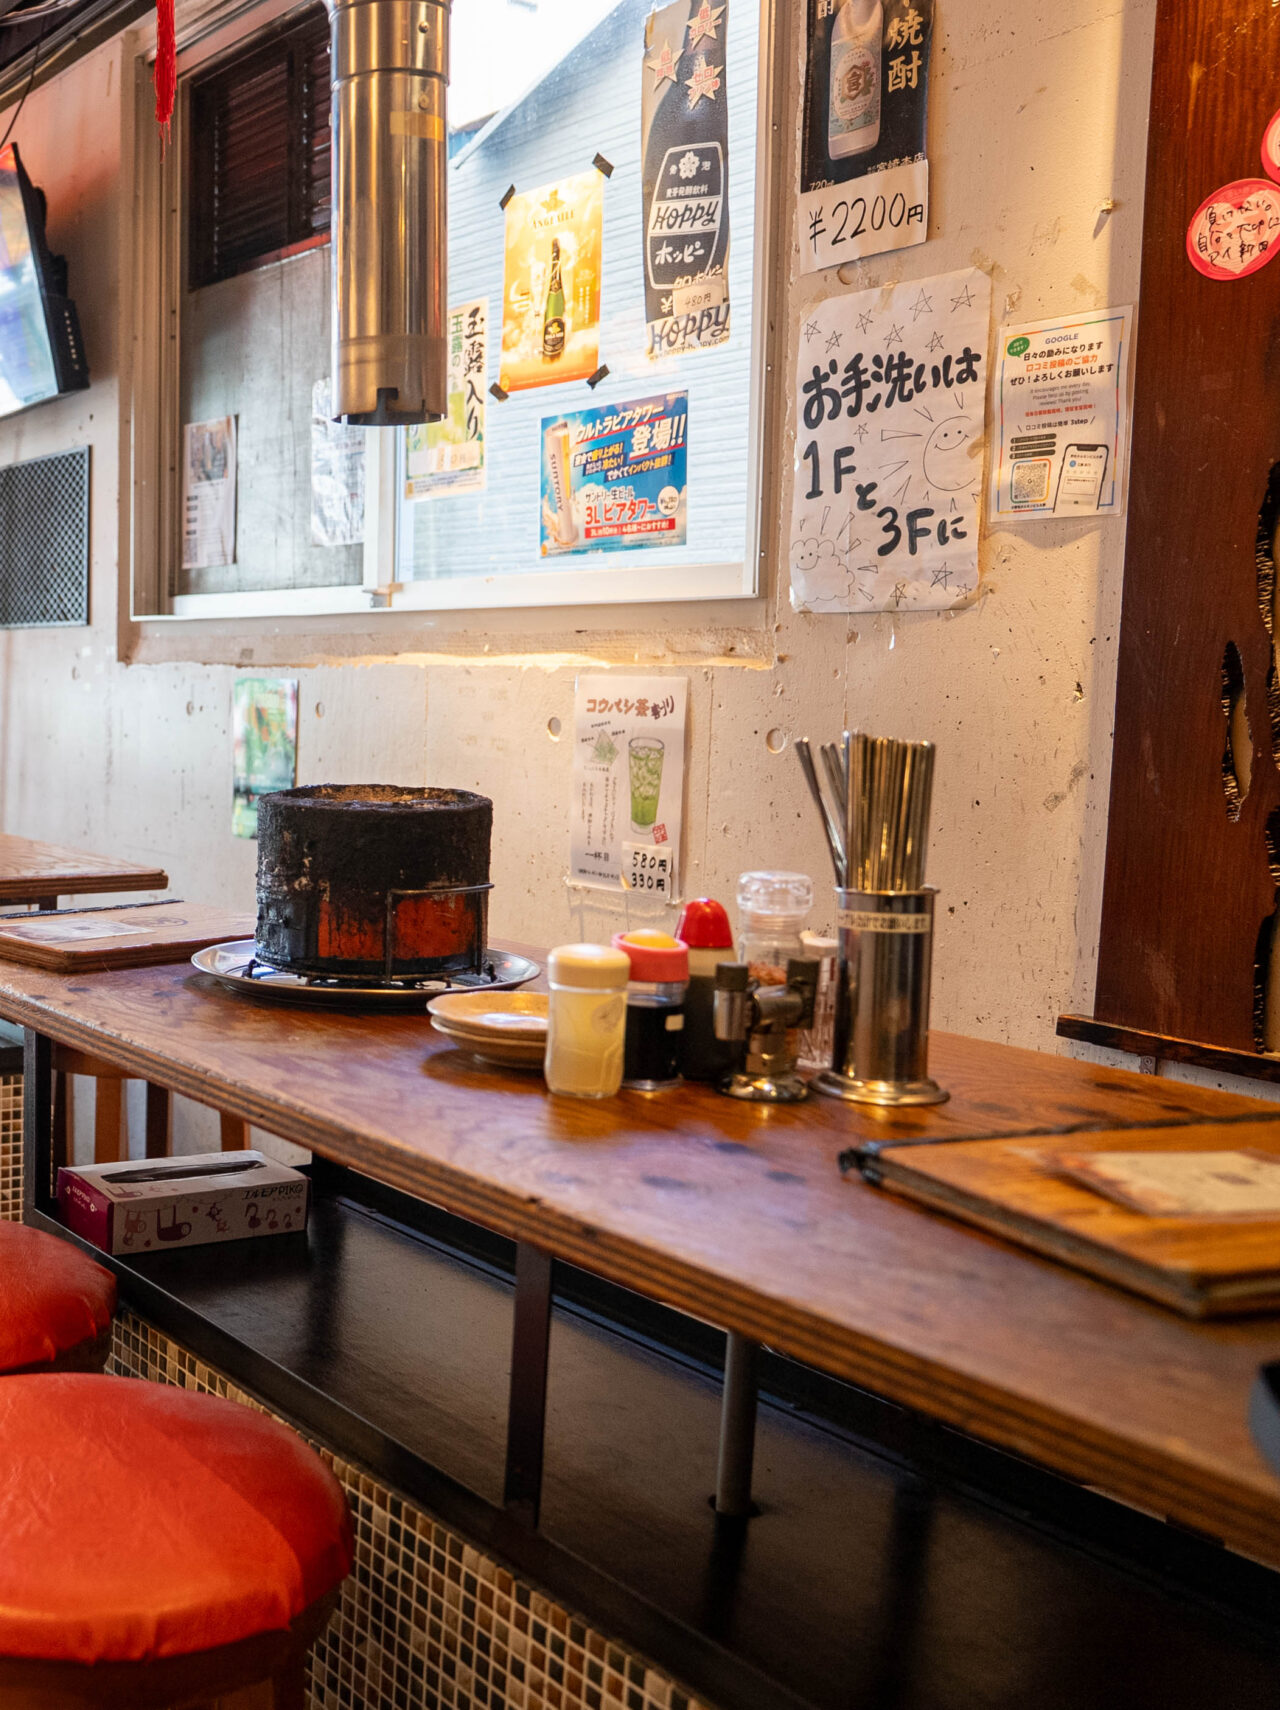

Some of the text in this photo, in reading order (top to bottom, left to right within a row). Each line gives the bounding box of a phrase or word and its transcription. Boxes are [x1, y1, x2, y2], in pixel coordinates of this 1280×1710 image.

[652, 200, 719, 230] Hoppy
[809, 192, 924, 255] ¥2200円
[655, 240, 705, 265] ホッピー
[647, 303, 730, 355] Hoppy
[1045, 333, 1079, 345] GOOGLE
[1023, 341, 1104, 361] 日々の励みになります
[1026, 355, 1098, 373] 口コミ投稿のご協力
[803, 346, 982, 430] お手洗いは
[576, 404, 664, 441] ウルトラビアタワー
[628, 413, 686, 458] 登場!!
[604, 499, 656, 522] ビアタワー
[631, 851, 667, 873] 580円
[631, 872, 665, 892] 330円
